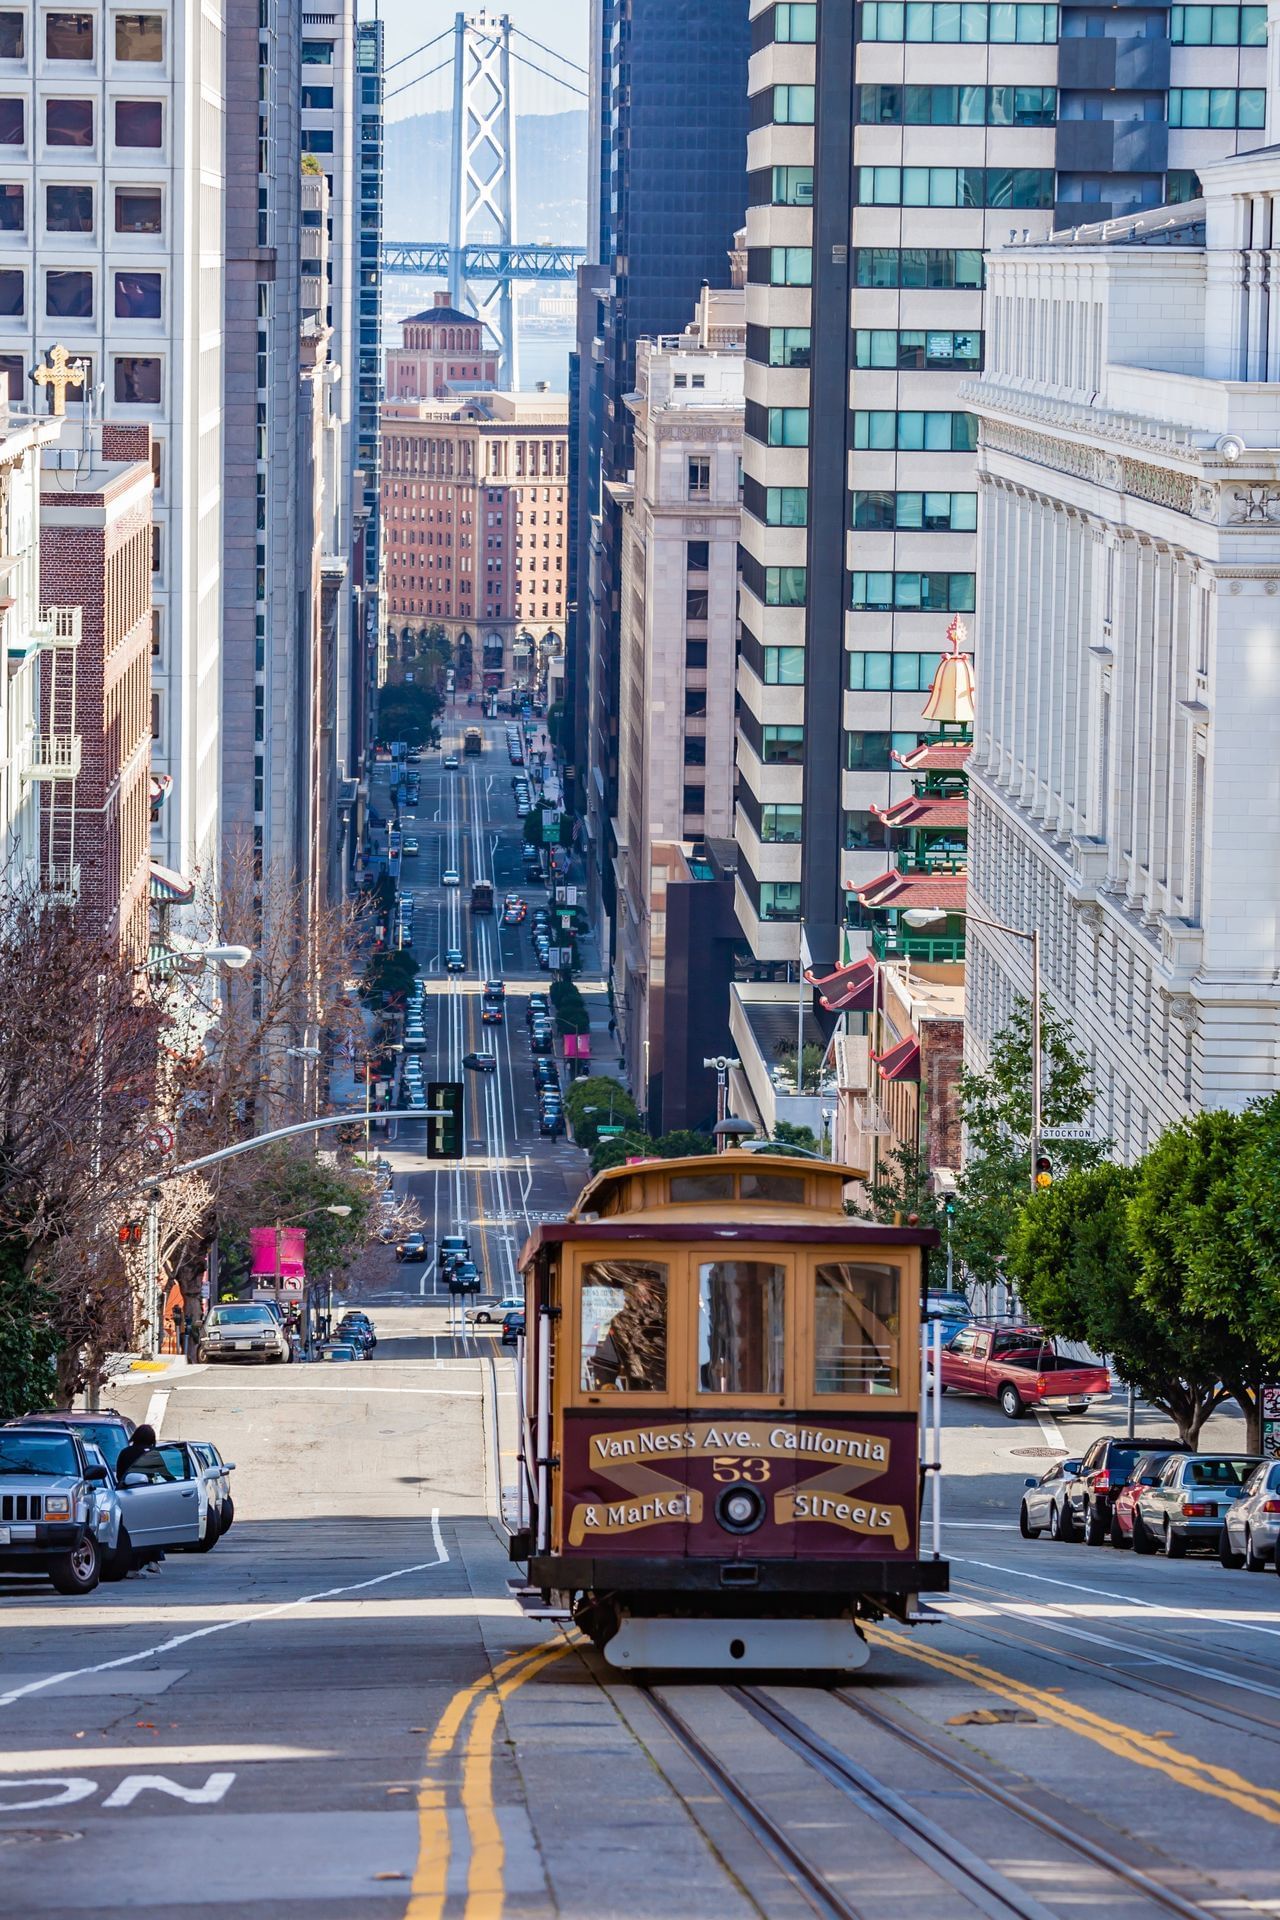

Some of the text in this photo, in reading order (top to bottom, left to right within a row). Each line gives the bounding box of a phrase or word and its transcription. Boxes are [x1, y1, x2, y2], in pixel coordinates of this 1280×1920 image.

[1043, 1130, 1091, 1138] STOCKTON
[595, 1437, 635, 1458] Van
[638, 1431, 696, 1453] Ness
[769, 1429, 886, 1461] California
[713, 1457, 771, 1483] 53
[584, 1494, 892, 1528] & Market Streets
